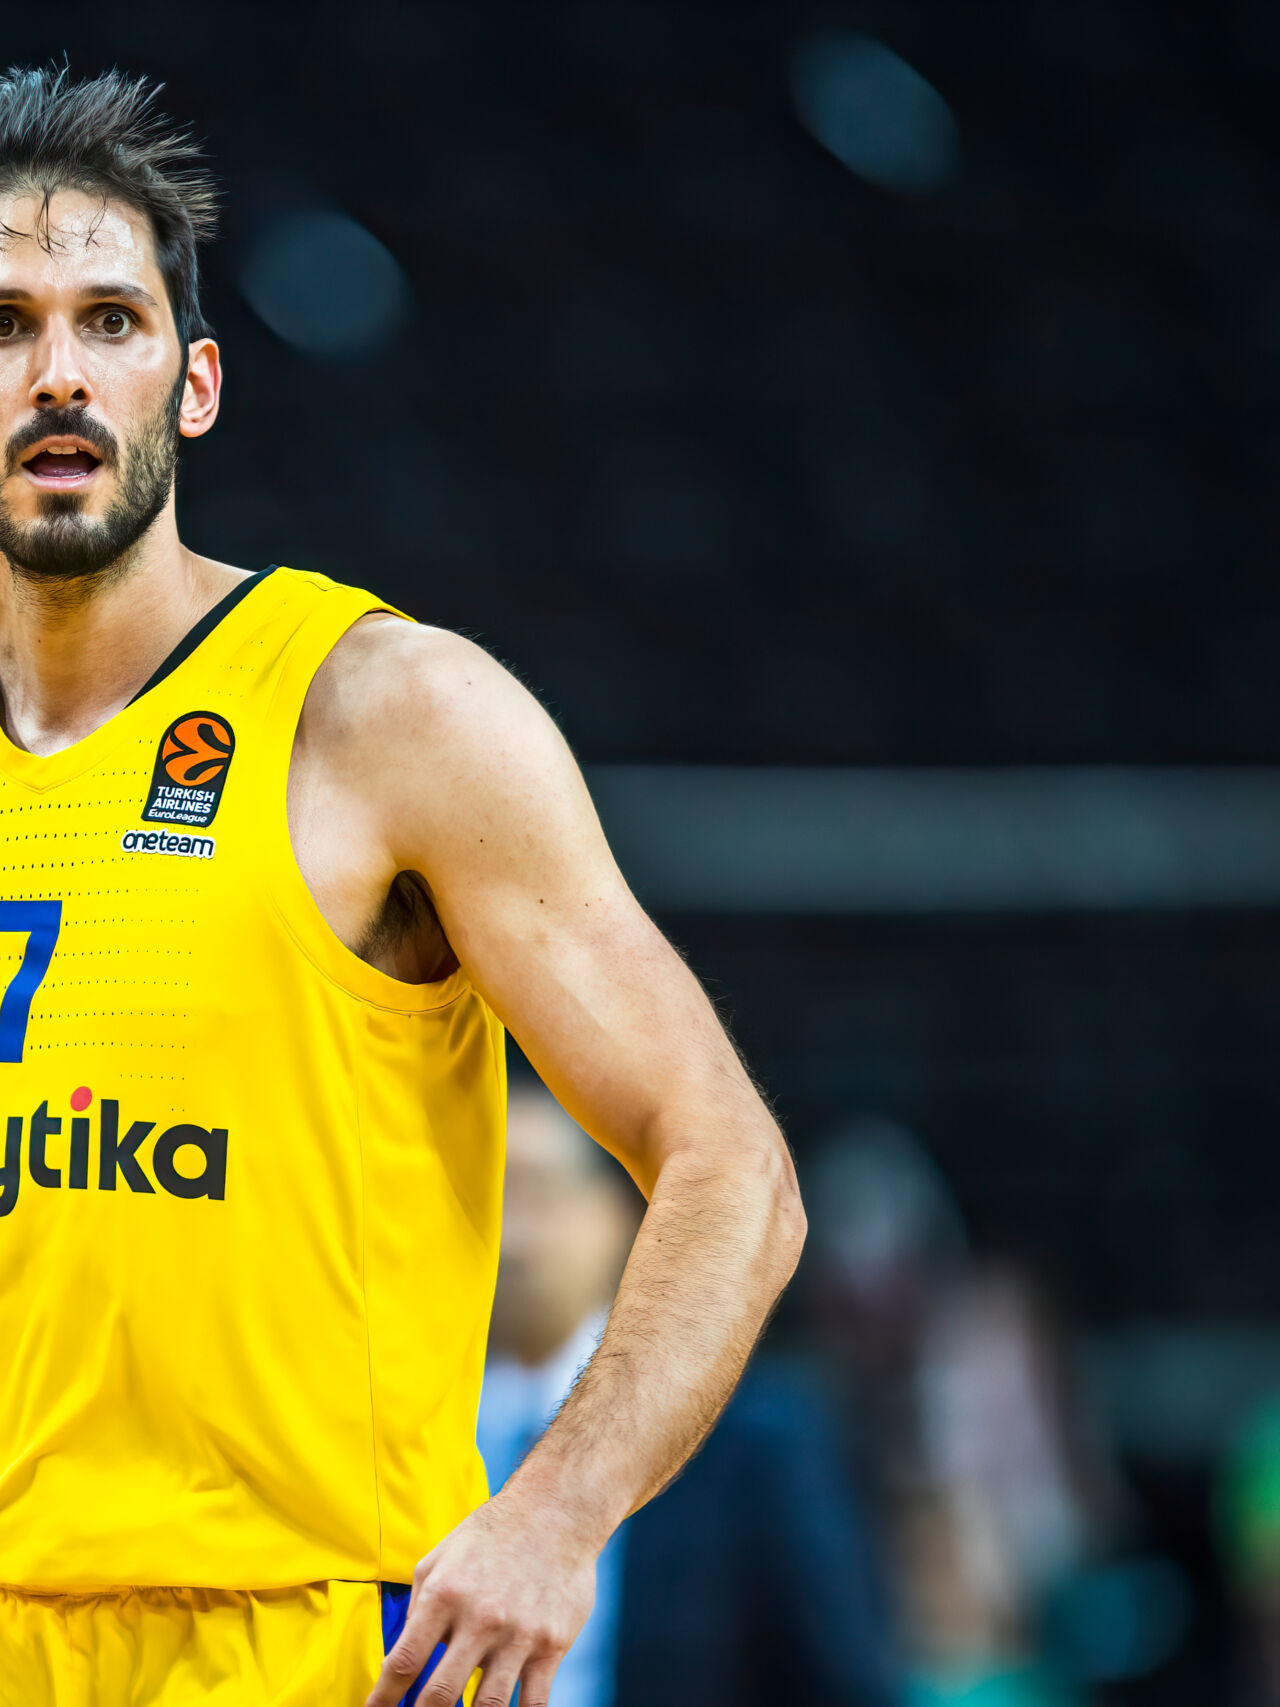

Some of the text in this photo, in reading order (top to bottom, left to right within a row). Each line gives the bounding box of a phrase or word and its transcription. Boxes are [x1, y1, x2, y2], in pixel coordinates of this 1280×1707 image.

[157, 786, 215, 802] TURKISH
[152, 798, 212, 814] AIRLINES
[148, 808, 208, 823] EuroLeague
[122, 830, 214, 857] oneteam
